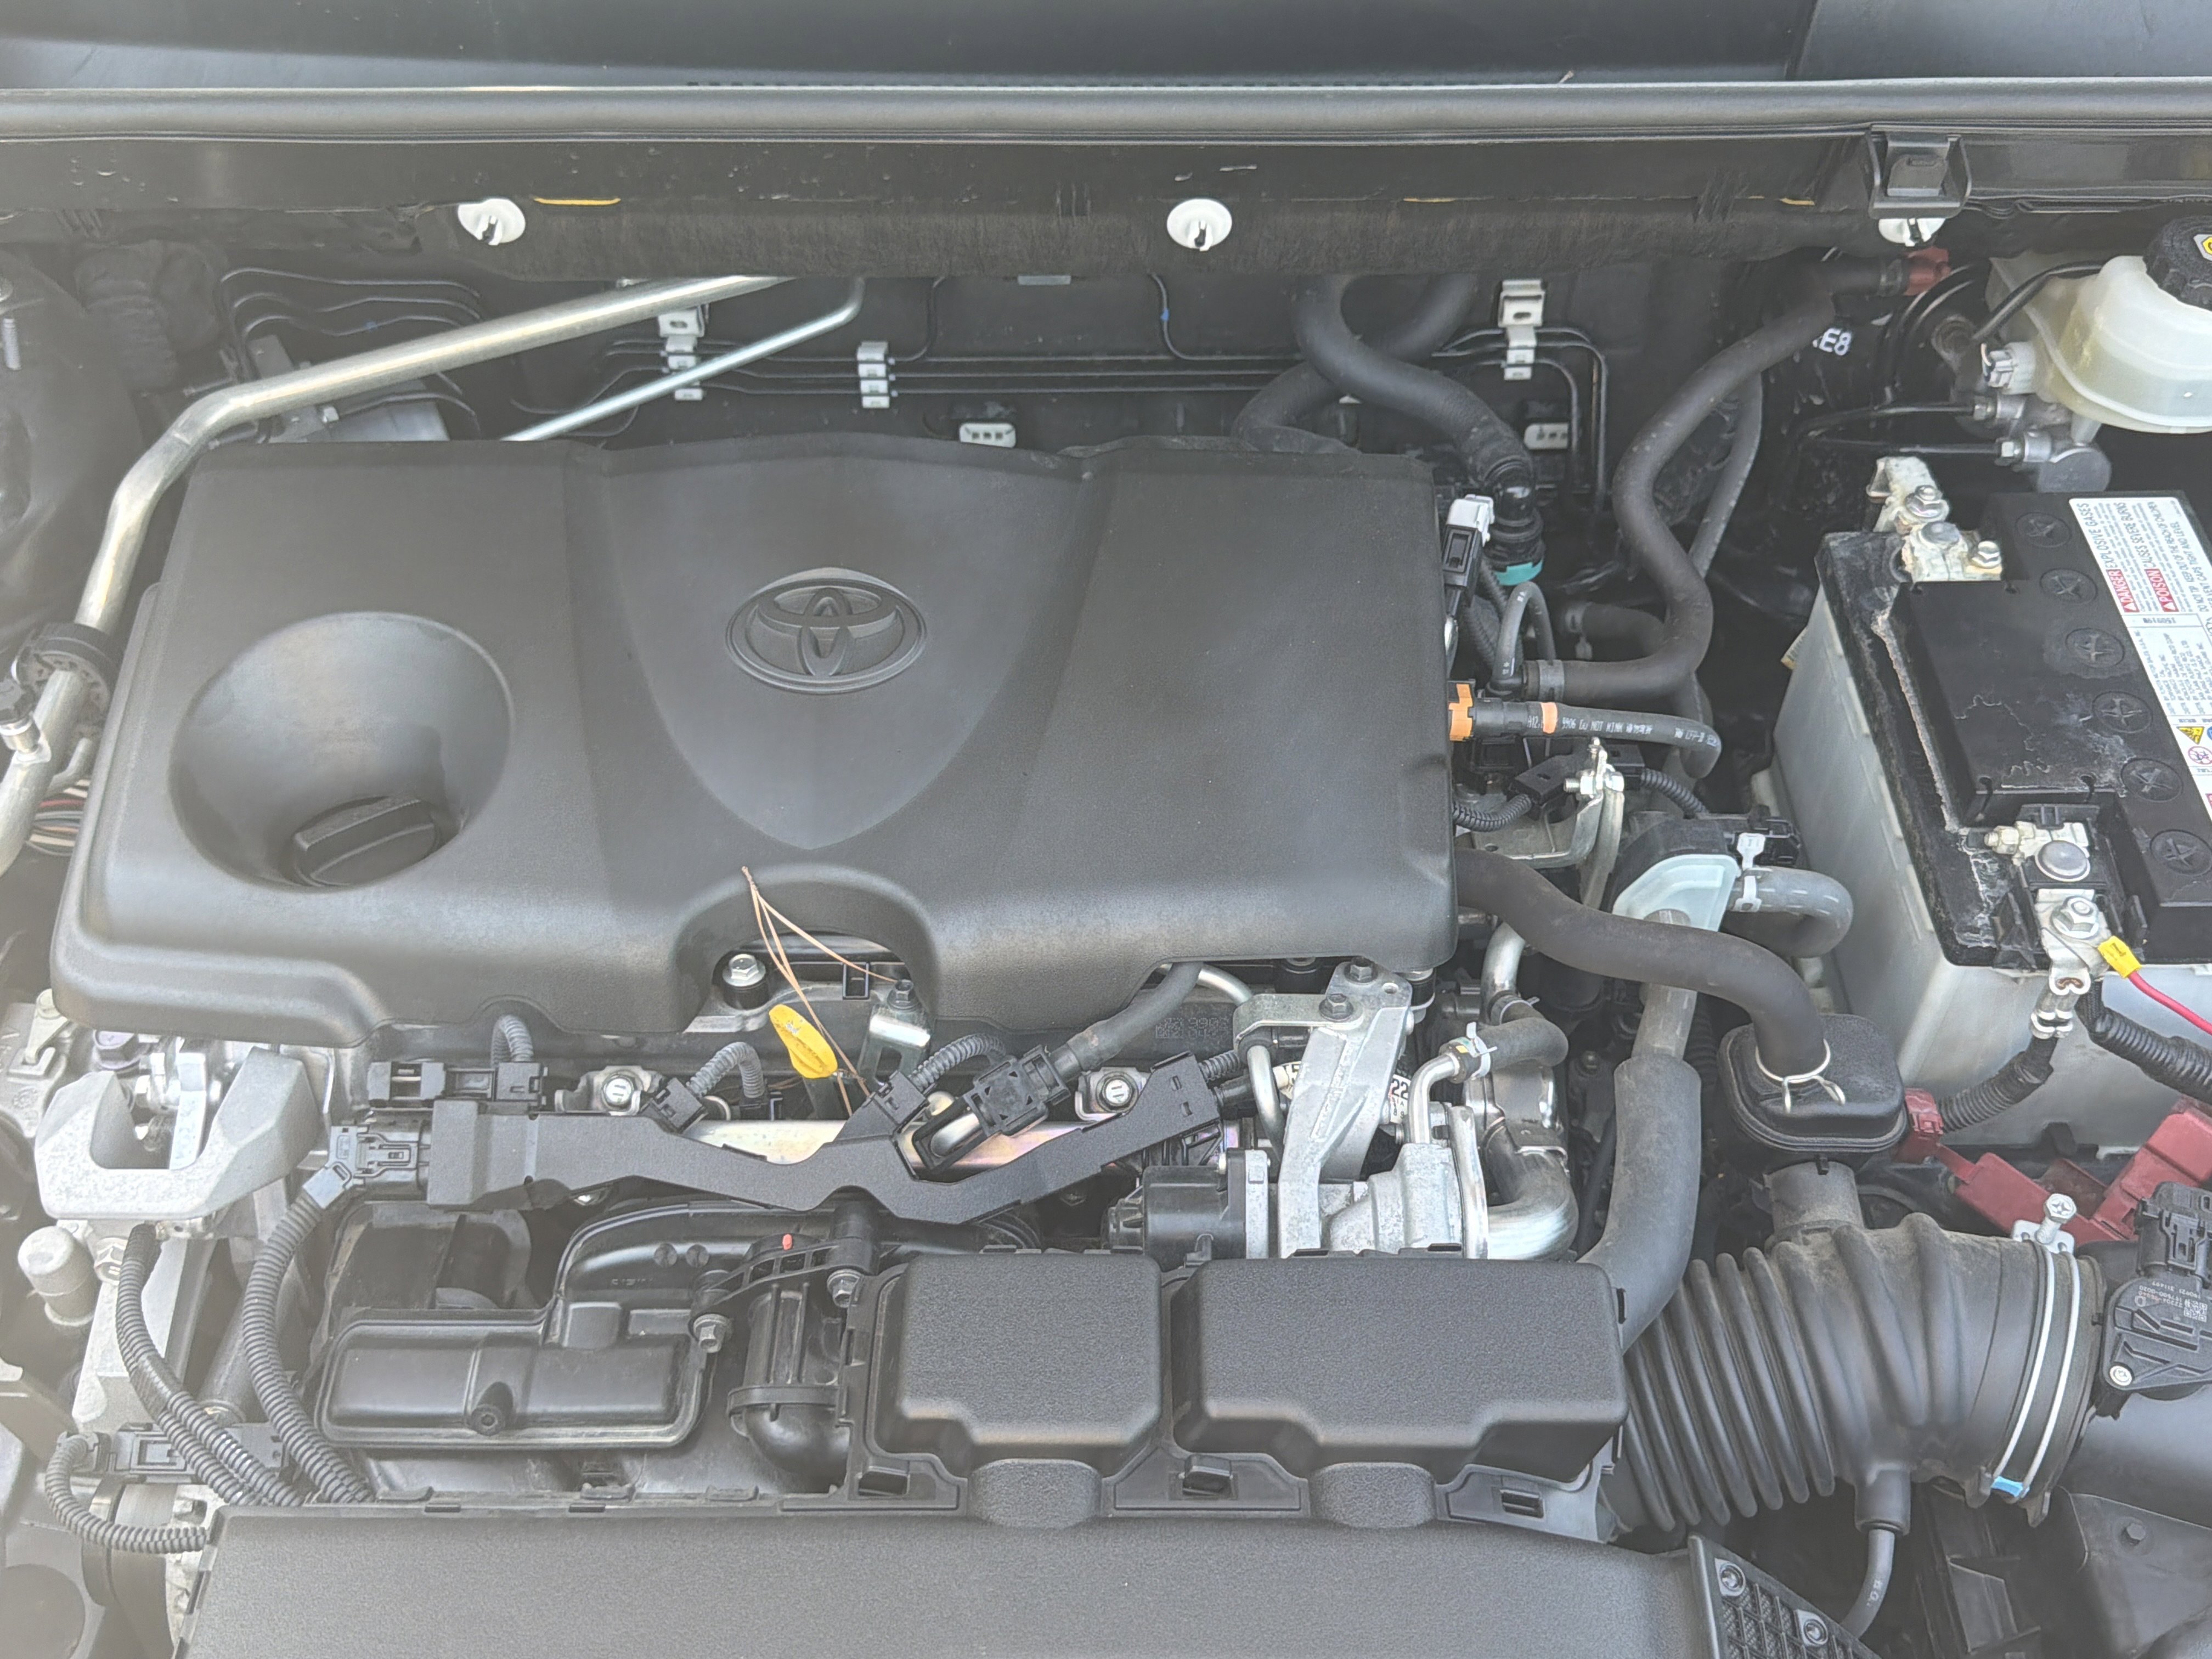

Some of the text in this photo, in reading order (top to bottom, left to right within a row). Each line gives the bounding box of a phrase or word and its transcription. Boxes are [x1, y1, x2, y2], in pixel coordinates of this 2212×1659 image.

[1813, 328, 1852, 356] E8
[2075, 503, 2098, 526] GASES
[2113, 502, 2134, 521] BURNS
[2123, 523, 2145, 543] SEVERE
[2160, 529, 2175, 543] REACH
[2087, 529, 2118, 567] EXPLOSIVE
[2178, 538, 2190, 548] AND
[2134, 545, 2156, 567] CAUSES
[2185, 551, 2198, 564] TIGHT
[2177, 561, 2188, 569] OUT
[2182, 572, 2194, 582] KEEP
[2193, 567, 2207, 580] CAPS
[2107, 571, 2135, 602] DANGER
[2145, 570, 2173, 601] POISON
[2193, 594, 2205, 603] NOT
[1590, 720, 1603, 731] NOT
[1606, 721, 1623, 733] KINK
